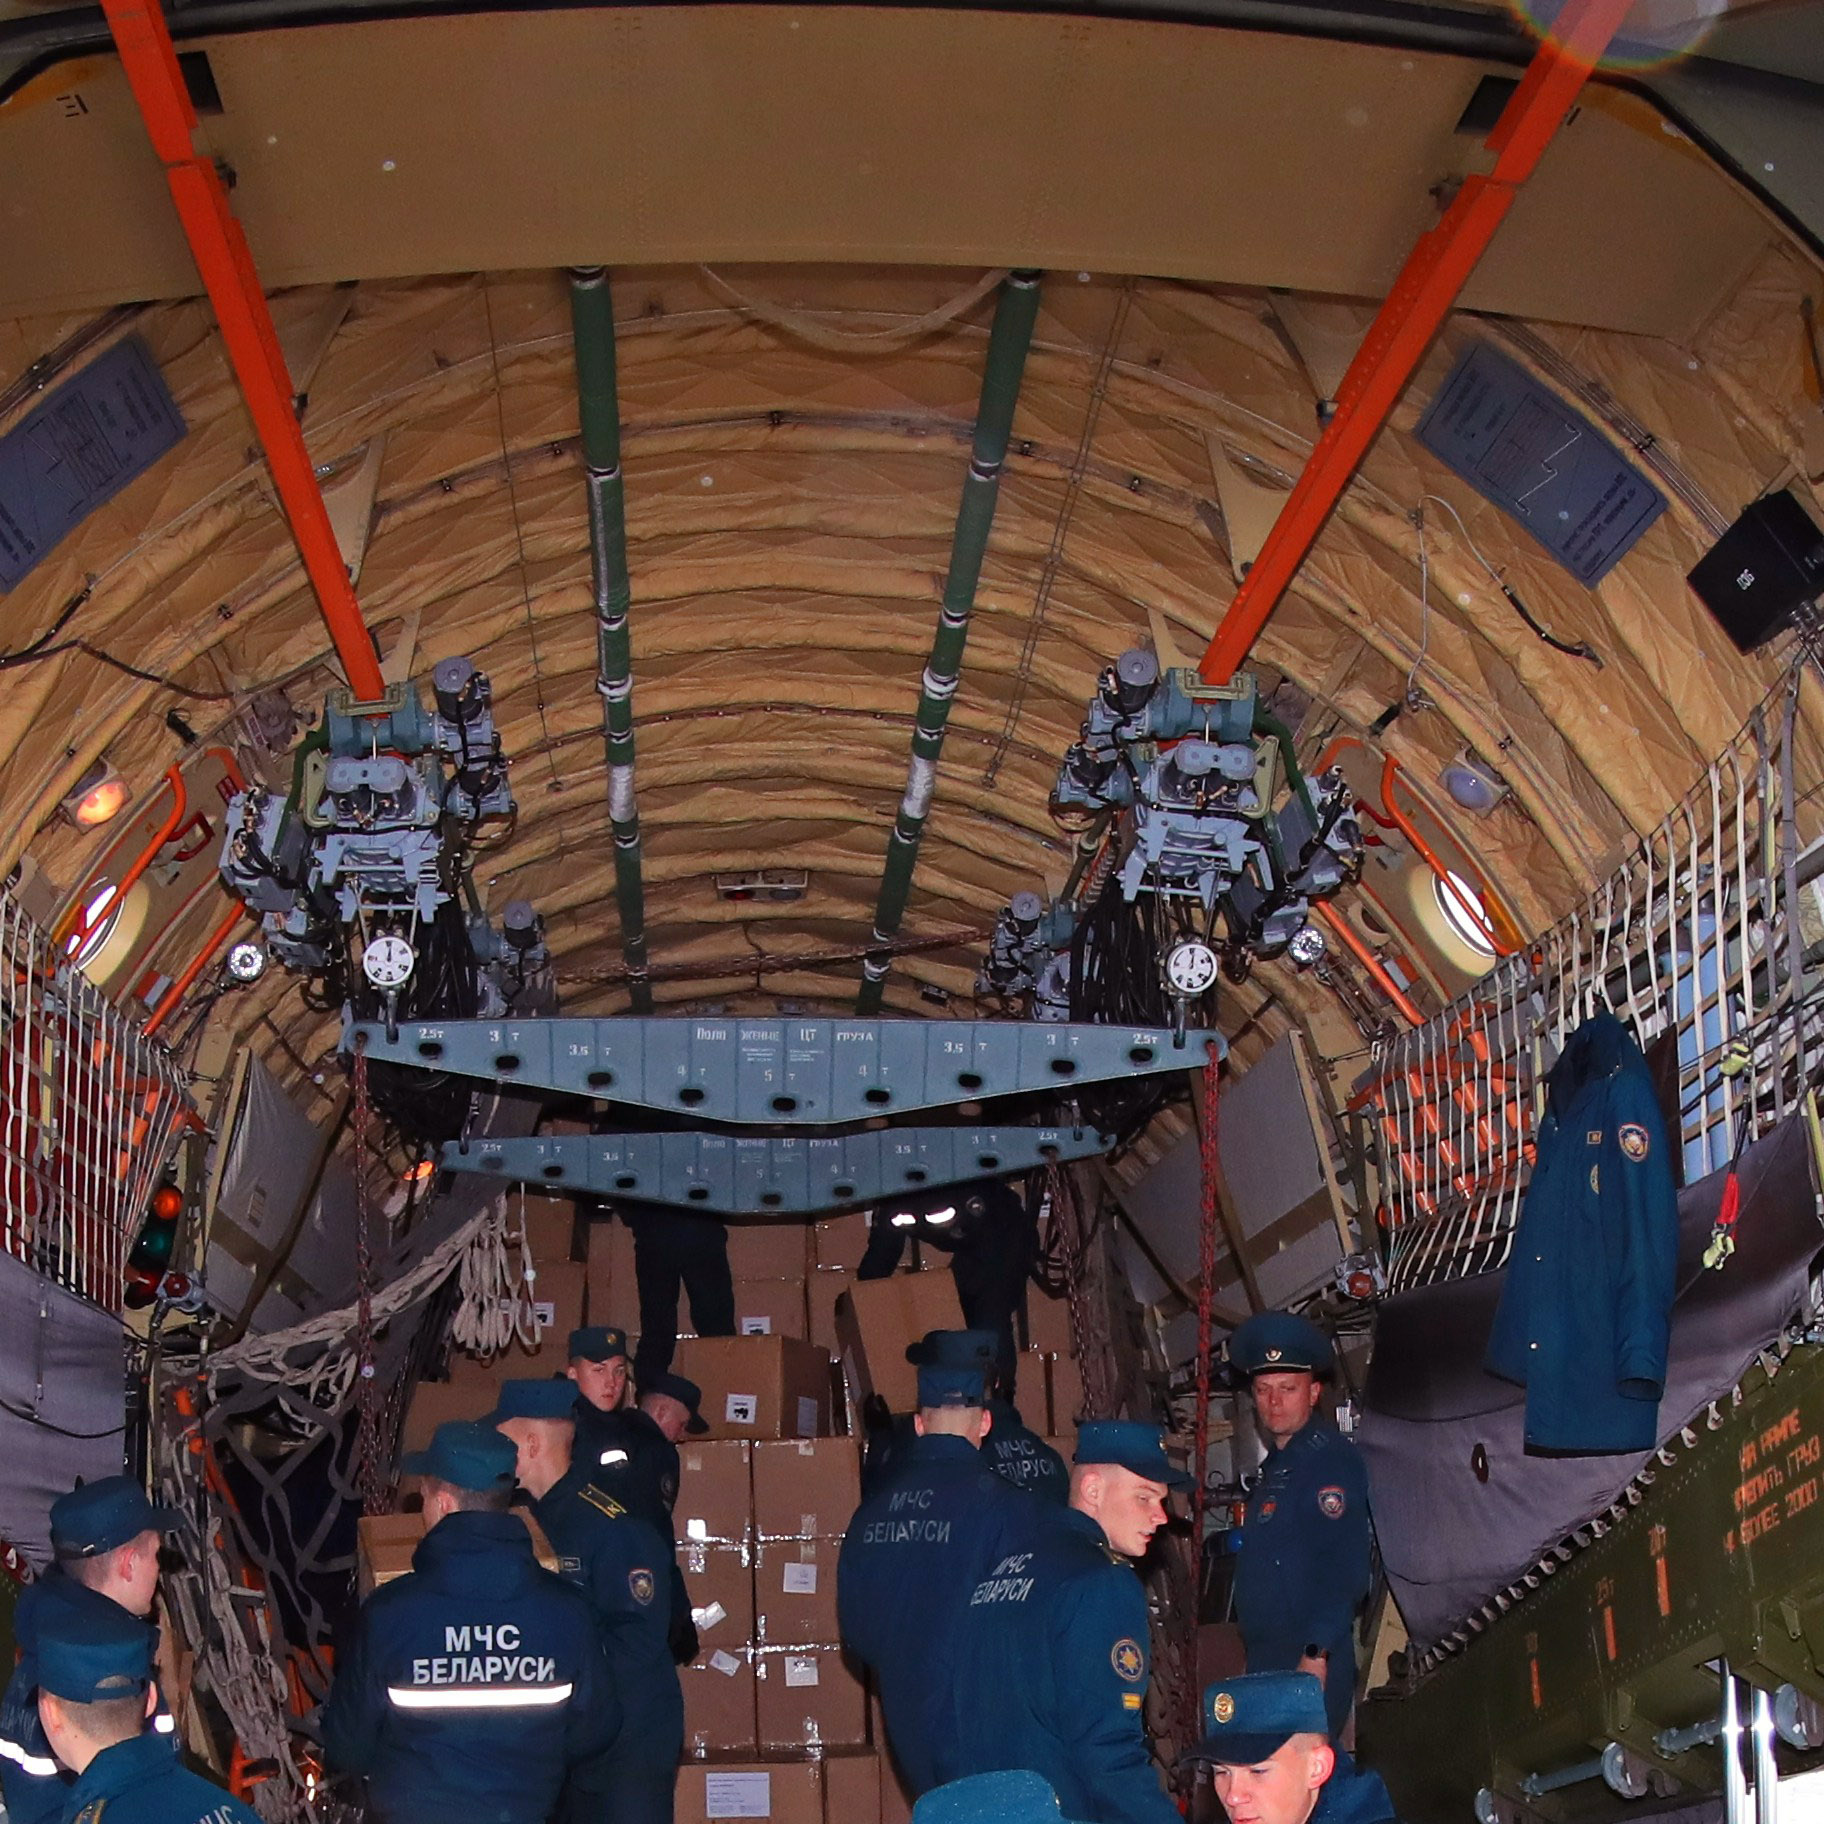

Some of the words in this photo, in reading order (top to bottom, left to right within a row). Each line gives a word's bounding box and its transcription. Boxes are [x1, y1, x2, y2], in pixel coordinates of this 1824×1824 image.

[888, 1489, 934, 1512] МЧС
[445, 1624, 521, 1652] МЧС
[412, 1656, 556, 1685] БЕЛАРУСИ
